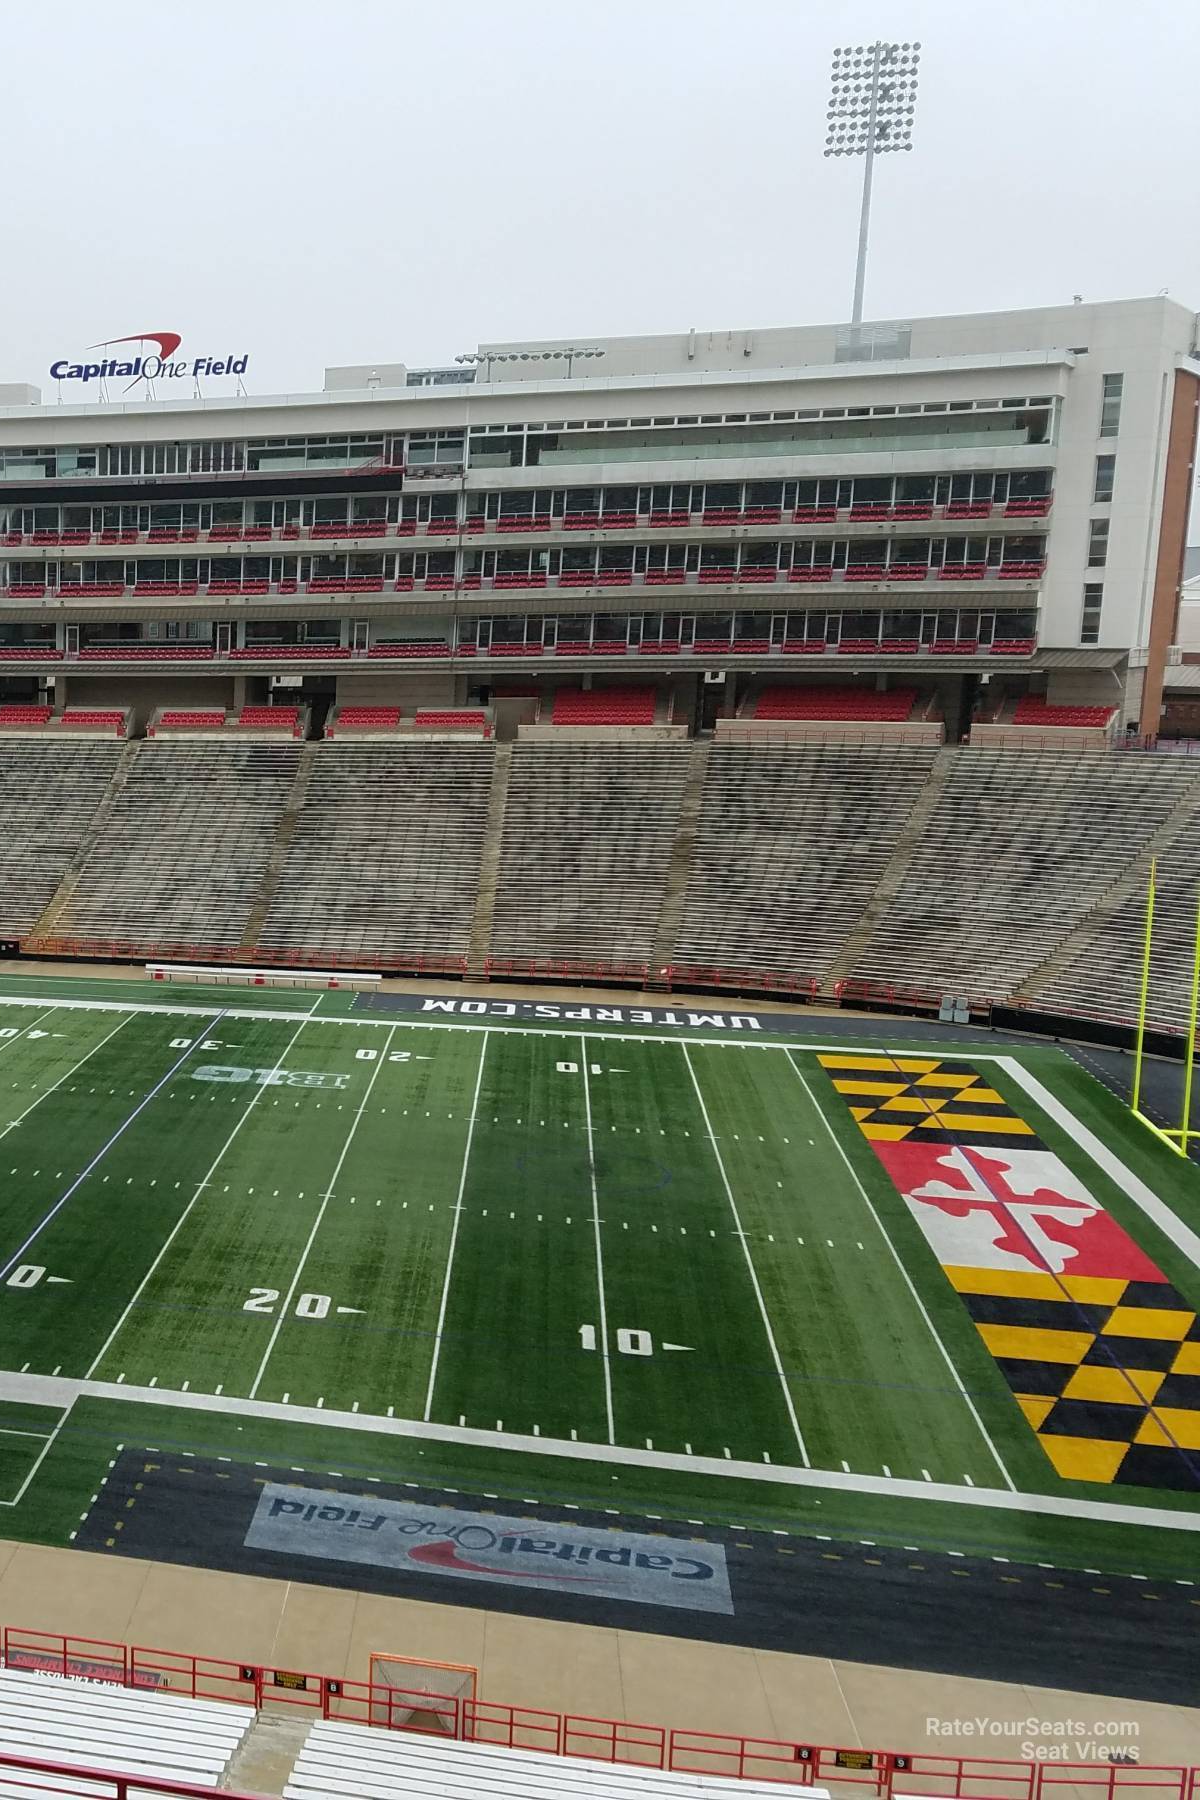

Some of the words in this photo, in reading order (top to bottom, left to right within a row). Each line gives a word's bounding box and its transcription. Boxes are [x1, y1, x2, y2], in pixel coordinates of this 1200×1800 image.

[192, 354, 248, 376] Field
[422, 999, 763, 1030] UMTERPS.COM
[169, 1038, 224, 1051] 30
[355, 1048, 411, 1062] 20
[556, 1062, 603, 1074] 10
[242, 1287, 332, 1319] 20
[578, 1324, 654, 1357] 10
[269, 1496, 389, 1532] Field
